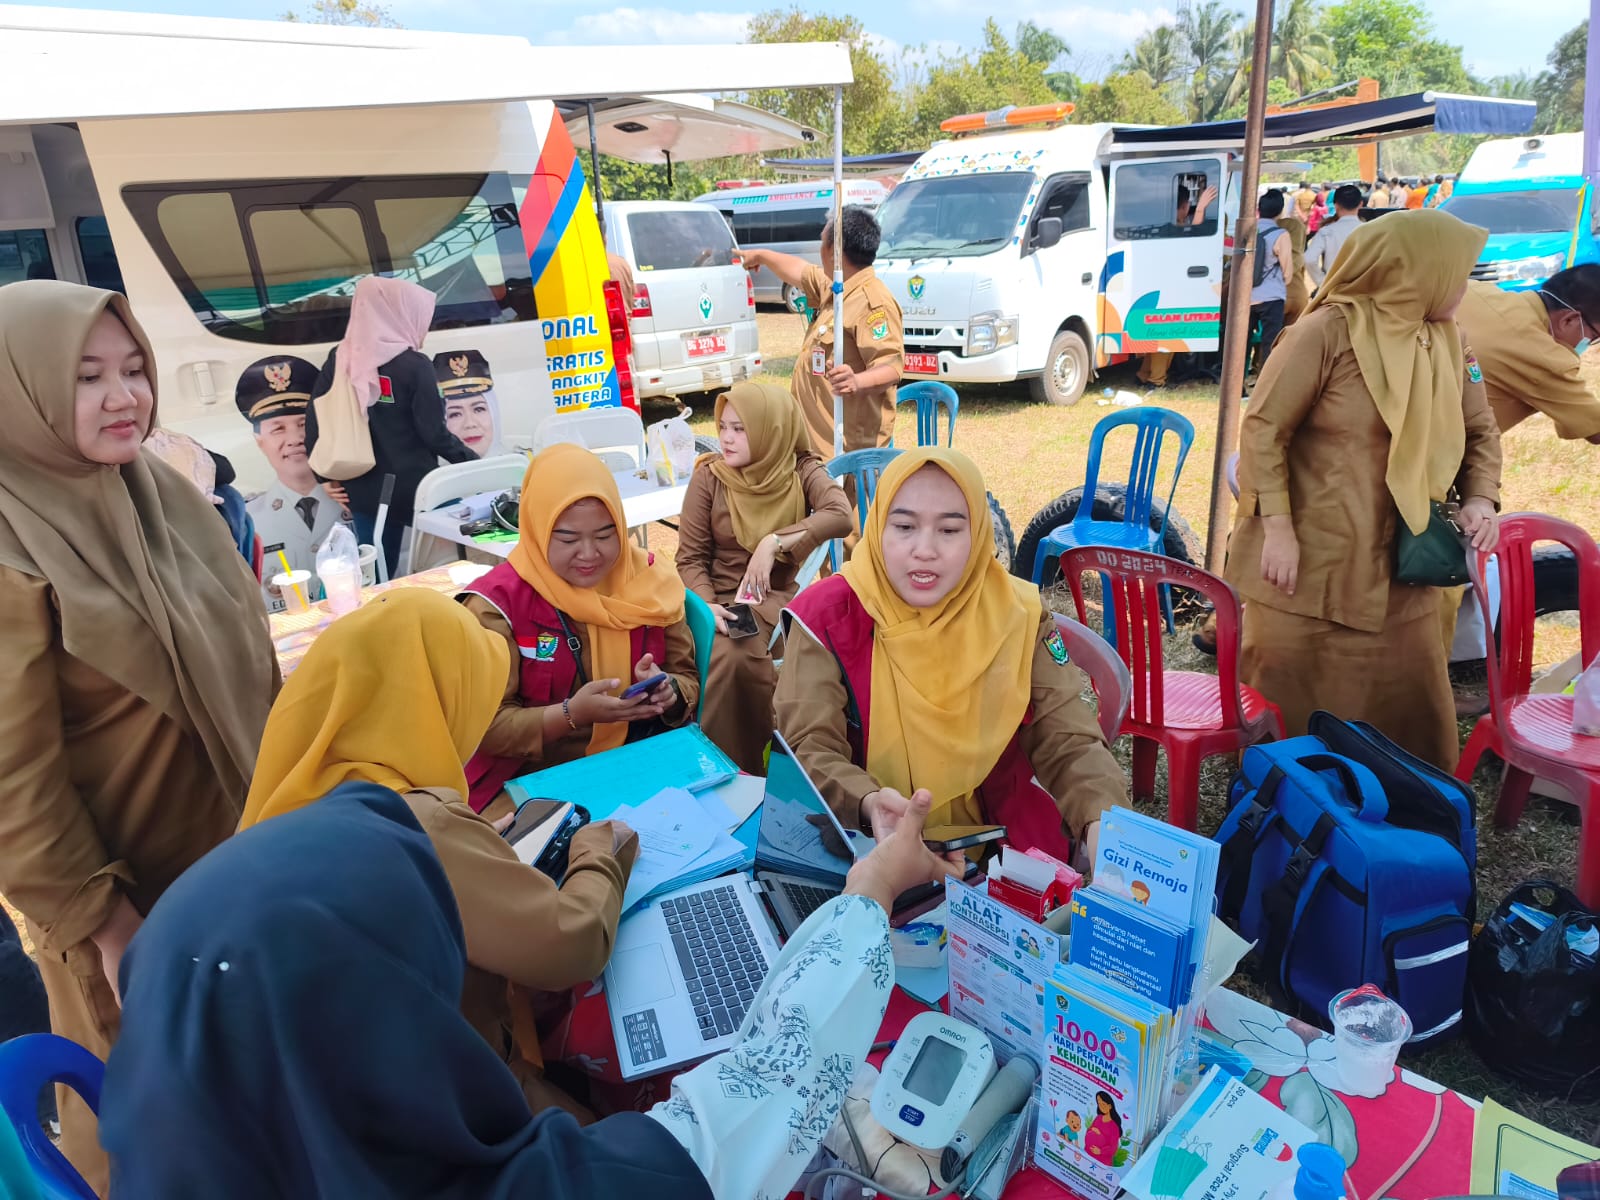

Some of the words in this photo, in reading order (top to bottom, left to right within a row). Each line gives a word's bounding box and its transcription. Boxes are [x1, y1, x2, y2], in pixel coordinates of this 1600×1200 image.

[768, 191, 816, 201] AMBULANCE
[542, 316, 598, 341] ONAL
[552, 372, 607, 390] ANGKIT
[1103, 848, 1129, 868] Gizi
[1132, 860, 1189, 894] Remaja
[950, 900, 1010, 941] KONTRASEPSI
[961, 894, 1003, 925] ALAT
[1055, 1014, 1117, 1062] 1000
[1053, 1034, 1075, 1051] HARI
[1076, 1044, 1120, 1077] PERTAMA
[1056, 1045, 1117, 1087] KEHIDUPAN
[1226, 1095, 1239, 1108] pcs
[1237, 1086, 1246, 1097] 50
[1223, 1143, 1250, 1176] Surgical
[1209, 1171, 1229, 1194] Face
